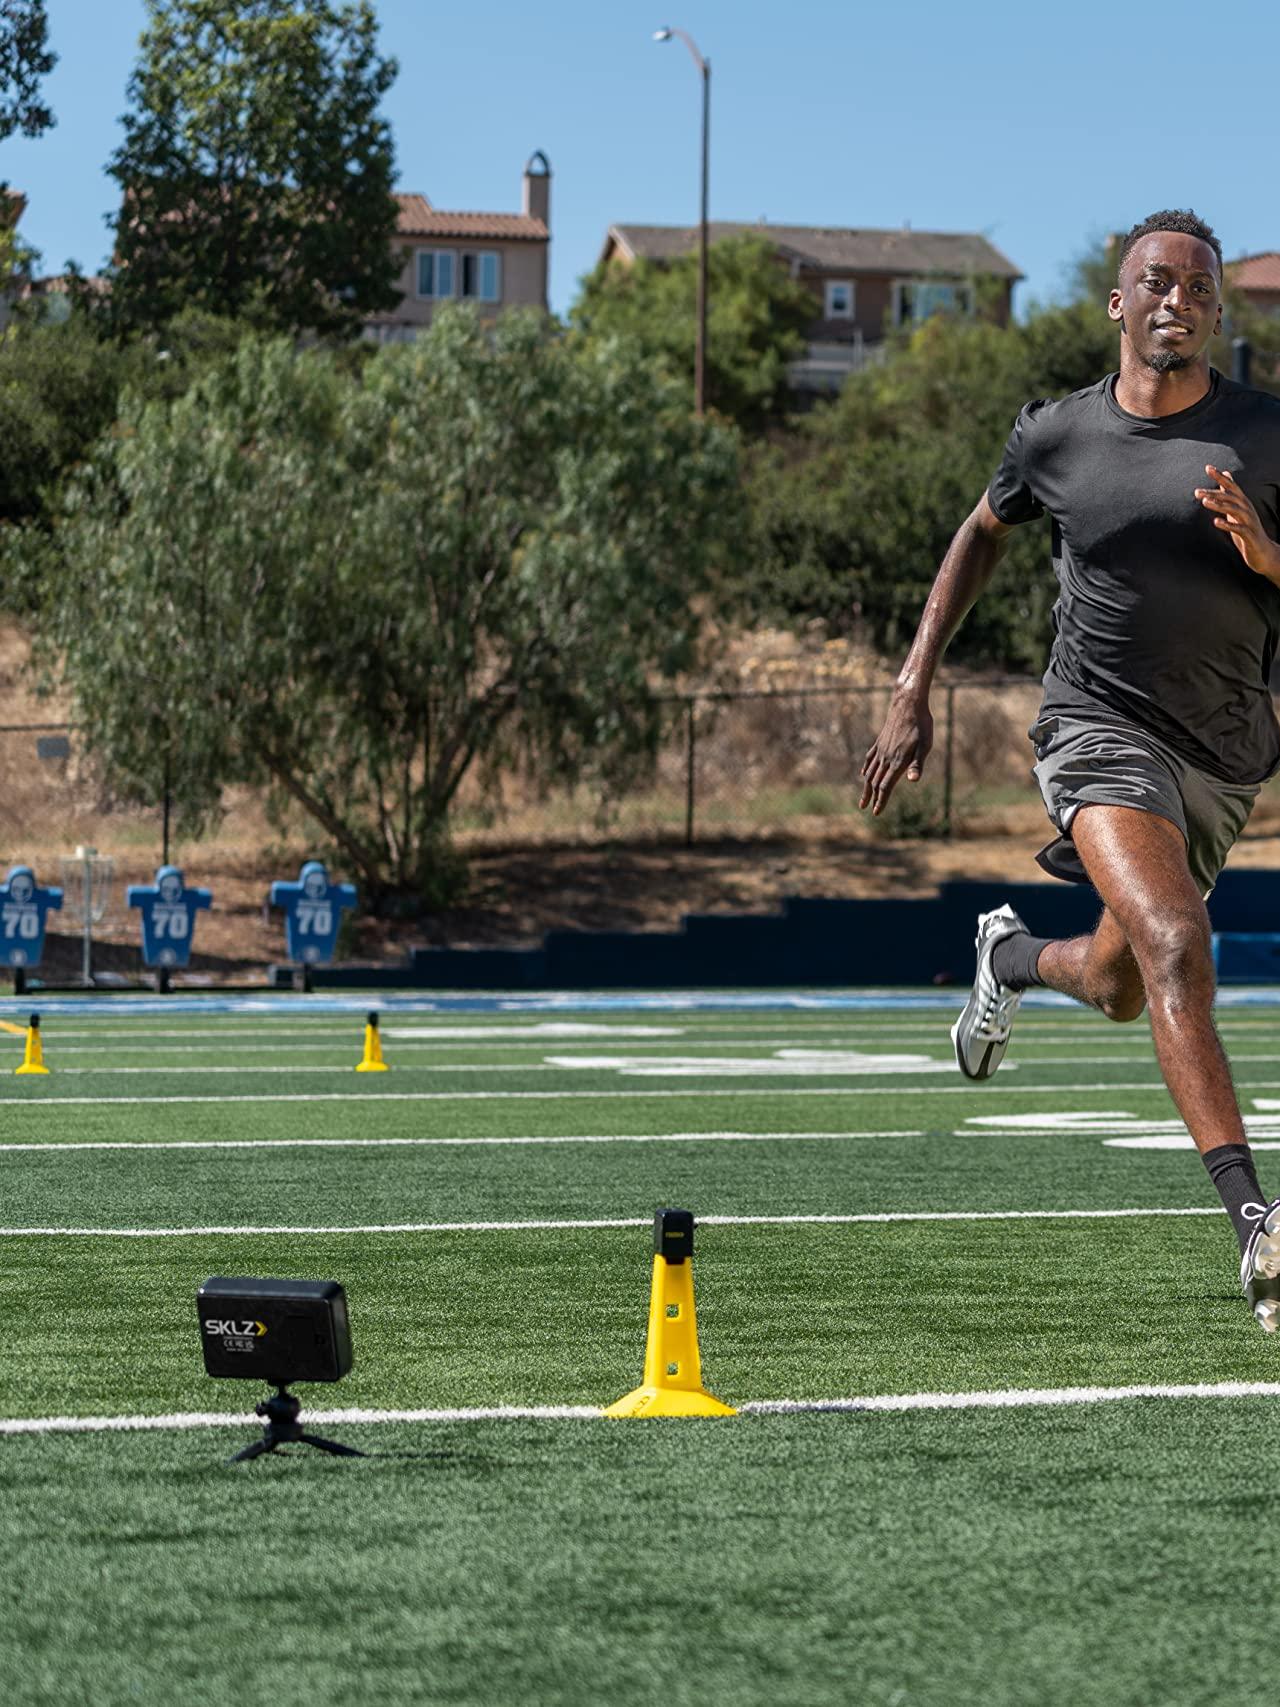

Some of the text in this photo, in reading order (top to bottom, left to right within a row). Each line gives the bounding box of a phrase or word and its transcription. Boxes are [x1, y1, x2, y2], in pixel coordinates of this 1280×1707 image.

[2, 910, 39, 939] 70
[151, 909, 188, 939] 70
[295, 908, 332, 936] 70
[205, 1319, 256, 1336] SKLZ
